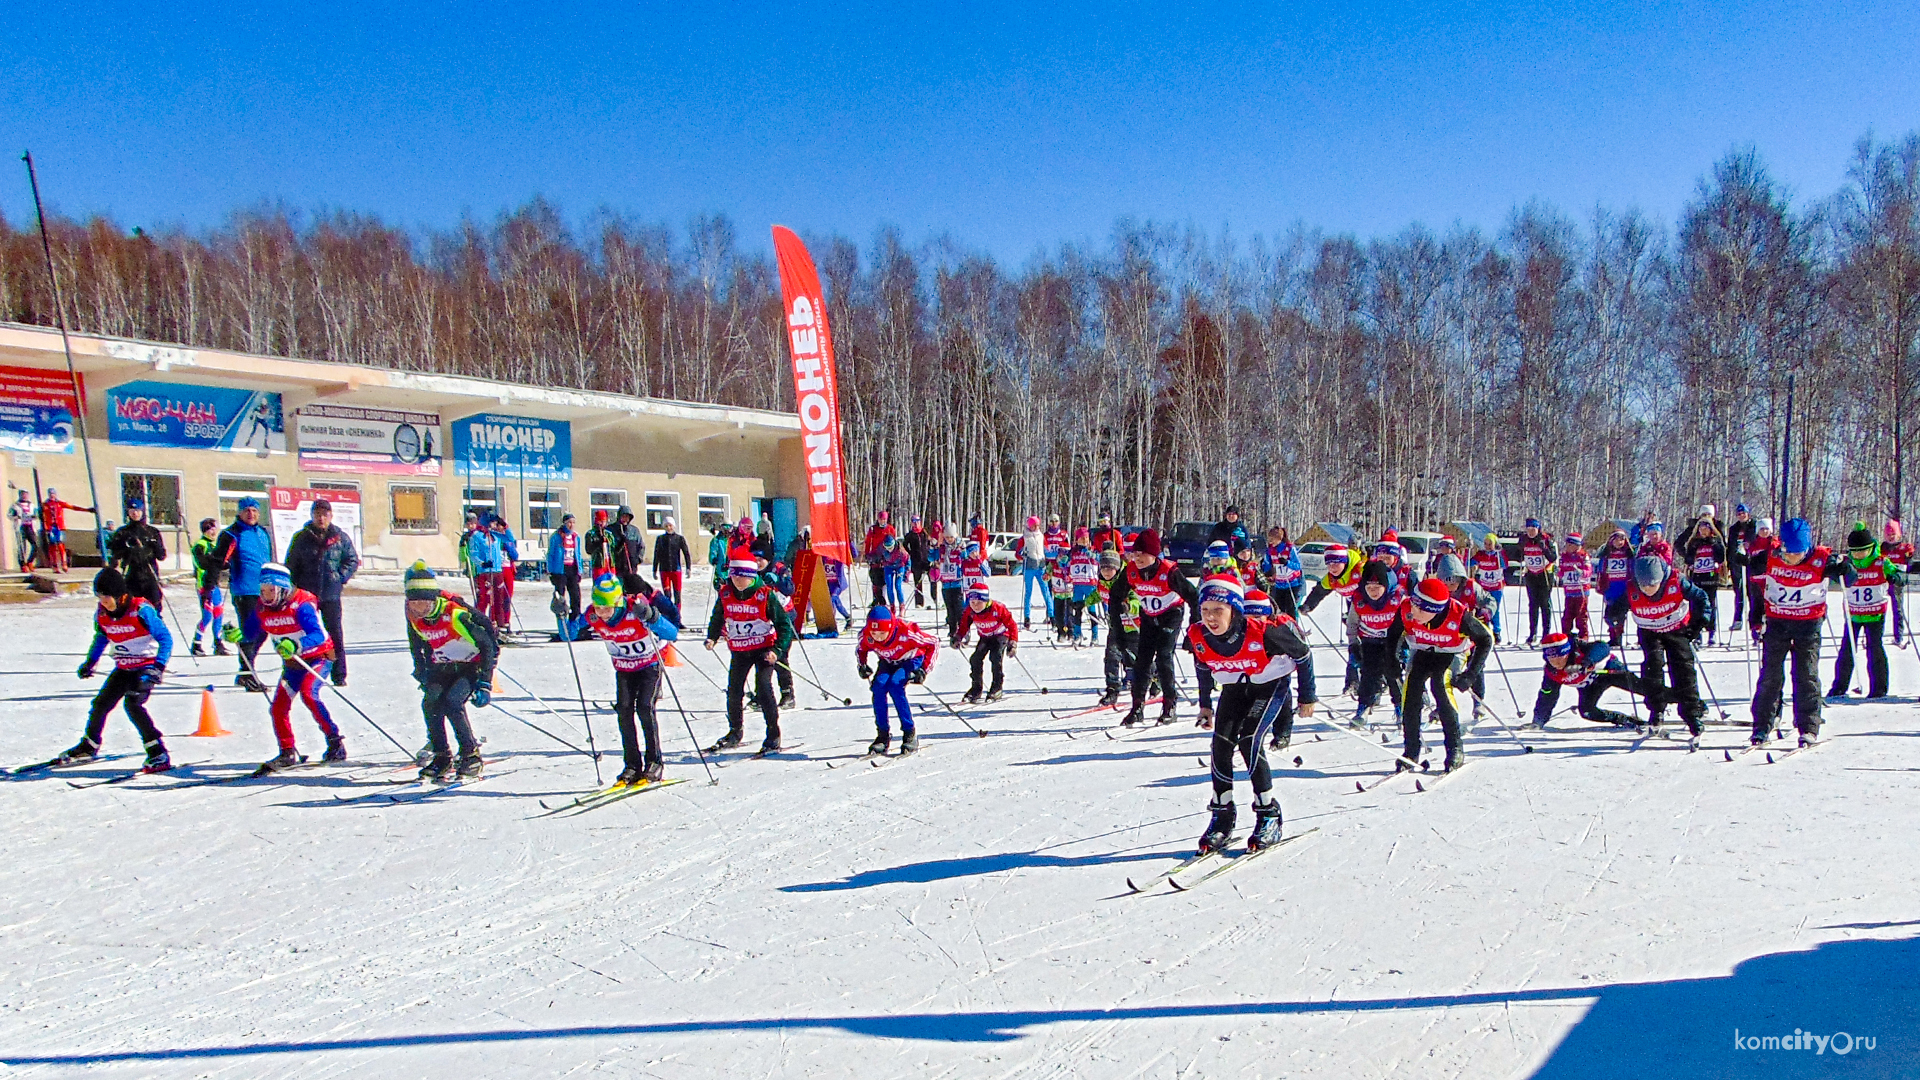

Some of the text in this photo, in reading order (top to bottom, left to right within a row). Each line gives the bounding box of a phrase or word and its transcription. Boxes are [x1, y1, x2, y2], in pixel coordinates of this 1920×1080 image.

[185, 423, 225, 439] SPORT
[469, 423, 556, 453] ПИОНЕР
[525, 542, 530, 552] 1
[1528, 556, 1542, 566] 39
[1611, 559, 1626, 570] 29
[1697, 559, 1711, 569] 30
[825, 565, 836, 573] 64
[1074, 565, 1087, 574] 34
[1771, 567, 1813, 581] ПИОНЕР
[1484, 572, 1495, 581] 44
[1778, 587, 1803, 604] 24
[1852, 588, 1873, 602] 18
[1141, 597, 1162, 610] 10
[1361, 612, 1396, 622] ПИОНЕР
